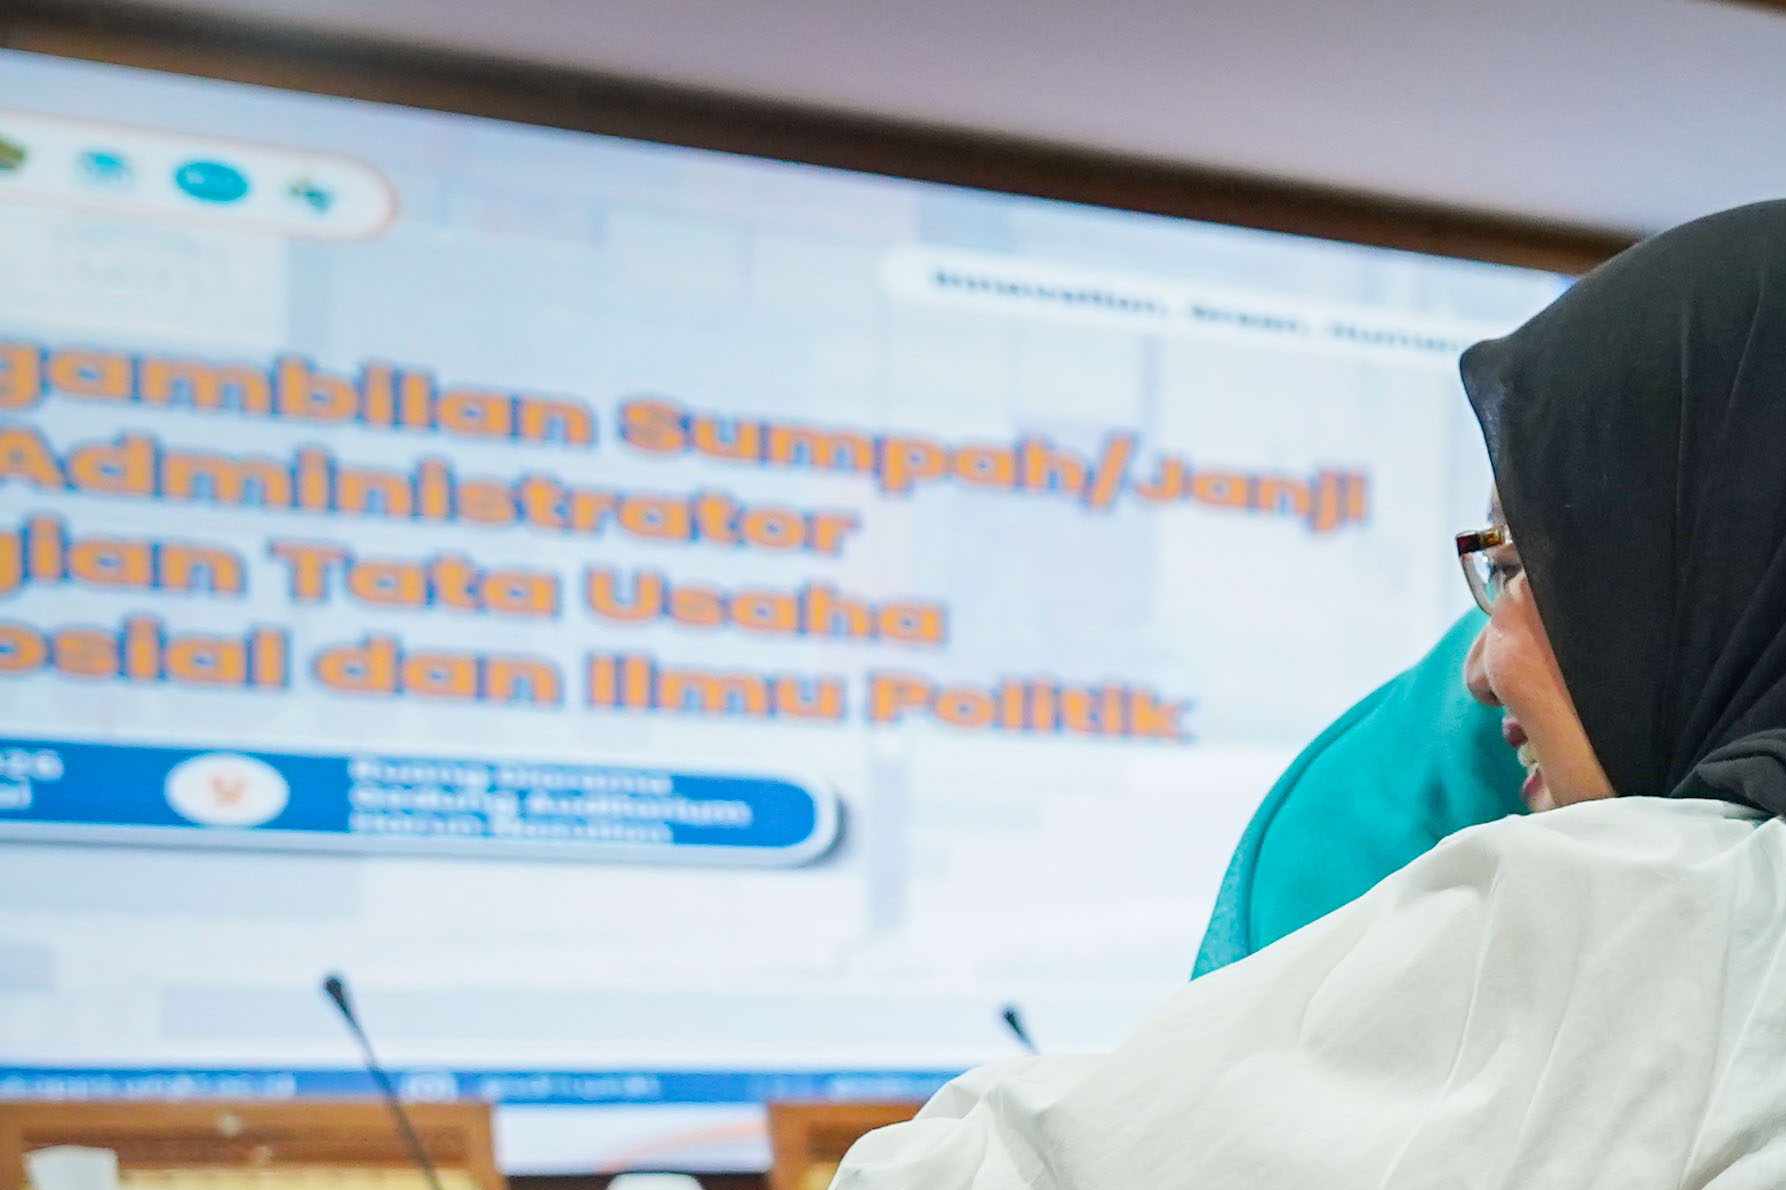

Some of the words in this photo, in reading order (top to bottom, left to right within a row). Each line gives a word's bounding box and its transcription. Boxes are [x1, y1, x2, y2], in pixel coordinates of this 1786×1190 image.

[0, 427, 862, 556] Administrator
[615, 395, 1372, 536] Sumpah/Janji
[0, 513, 246, 600] ian
[264, 538, 560, 620] Tata
[582, 565, 947, 646] Usaha
[316, 634, 562, 708] dan
[586, 649, 848, 724] Ilmu
[866, 670, 1197, 744] Politik
